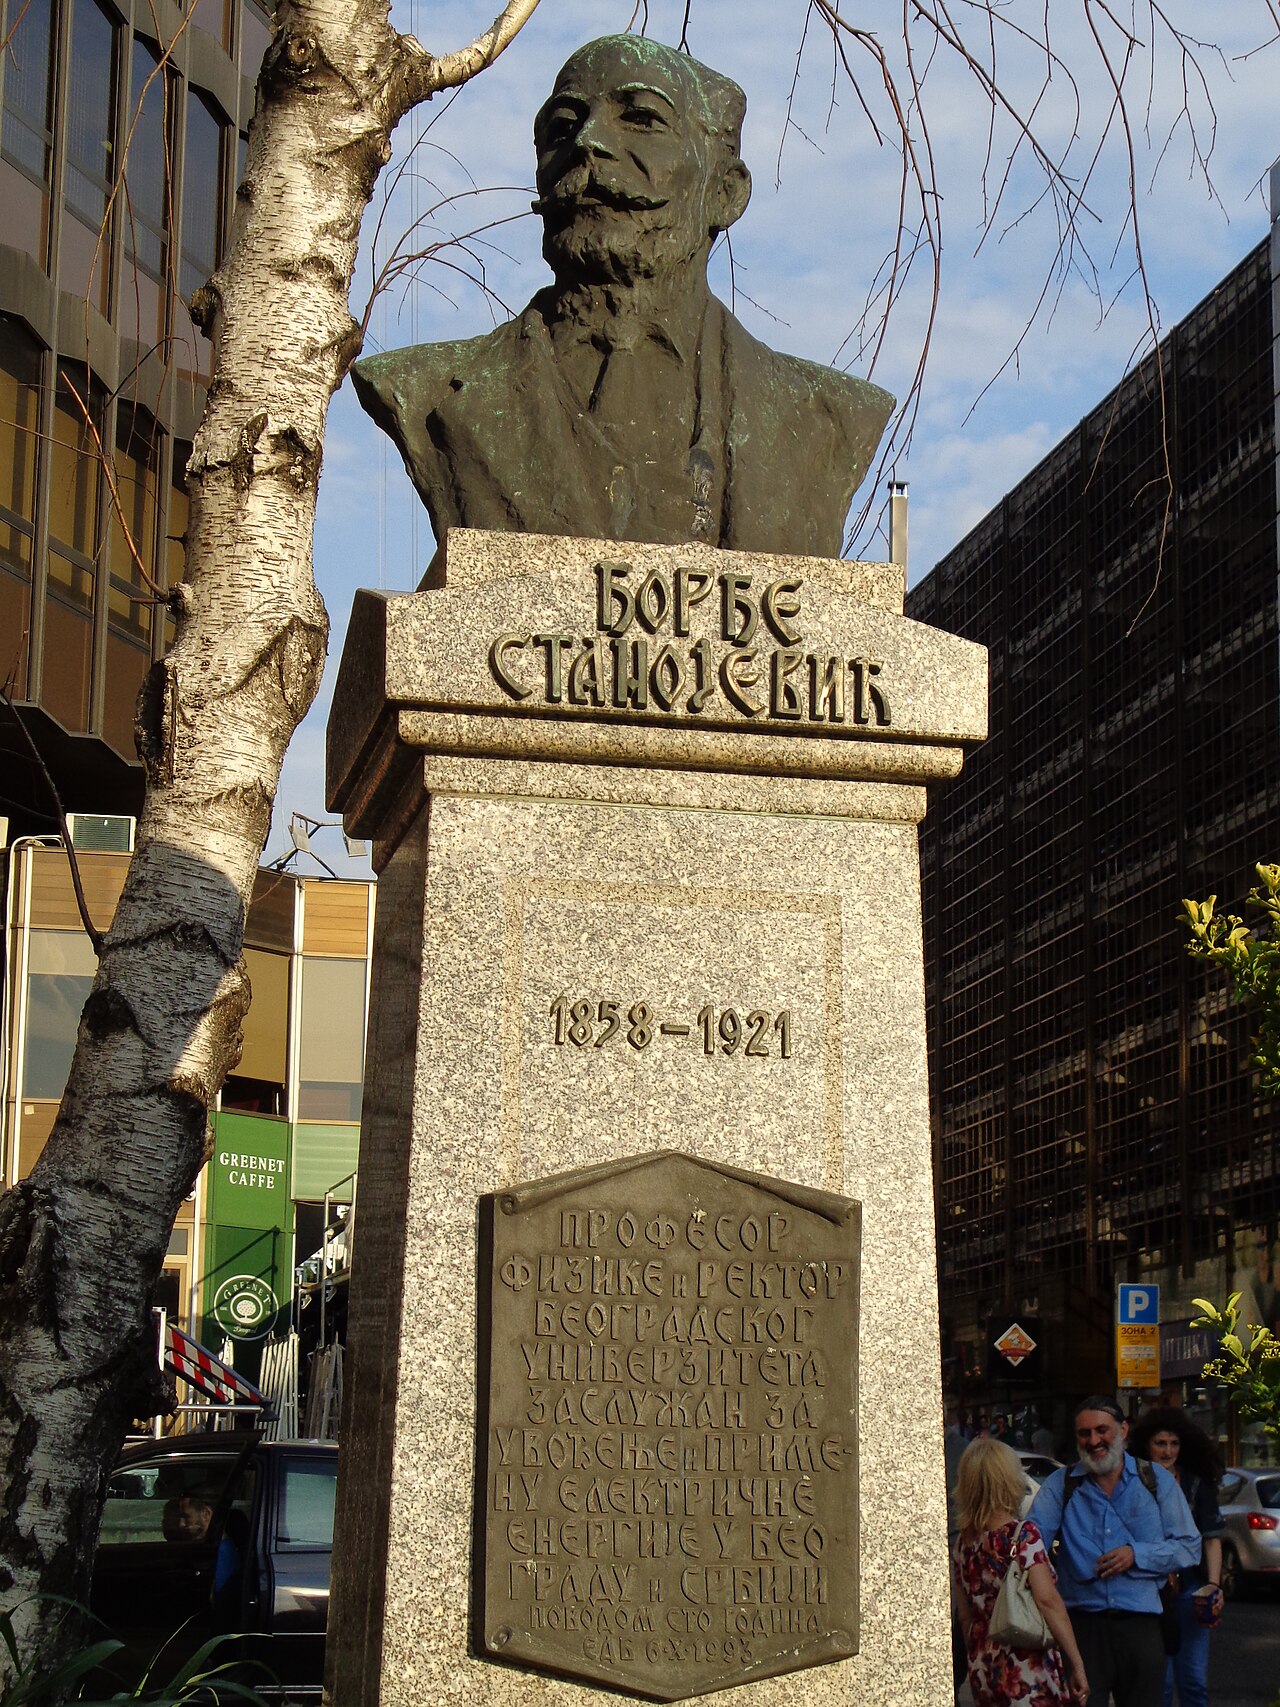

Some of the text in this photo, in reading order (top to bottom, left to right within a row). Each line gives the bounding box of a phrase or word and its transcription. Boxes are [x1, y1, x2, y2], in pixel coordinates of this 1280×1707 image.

[595, 560, 804, 648] ЂОРЂЕ
[488, 632, 892, 727] СТАНОЈЕВИЋ
[220, 1152, 285, 1173] GREENET
[229, 1170, 275, 1189] CAFFE
[560, 1208, 795, 1253] ПРОФЕСОР
[499, 1255, 665, 1297] ФИЗИКЕ
[697, 1259, 851, 1300] РЕКТОР
[535, 1300, 816, 1346] БЕОГРАДСКОГ
[1128, 1290, 1150, 1319] P
[1121, 1327, 1156, 1335] ЗОНА 2
[521, 1342, 826, 1387] УНИВЕРЗИТЕТА
[526, 1386, 818, 1431] ЗАСЛУЖАН ЗА
[494, 1472, 816, 1517] НУ ЕЛЕКТРИЧНЕ
[506, 1517, 702, 1560] ЕНЕРГИЈЕ
[508, 1561, 637, 1607] ГРАДУ
[680, 1564, 828, 1605] СРБИЈИ
[529, 1604, 822, 1638] ПОВОДОМ СТО ГОДИНА
